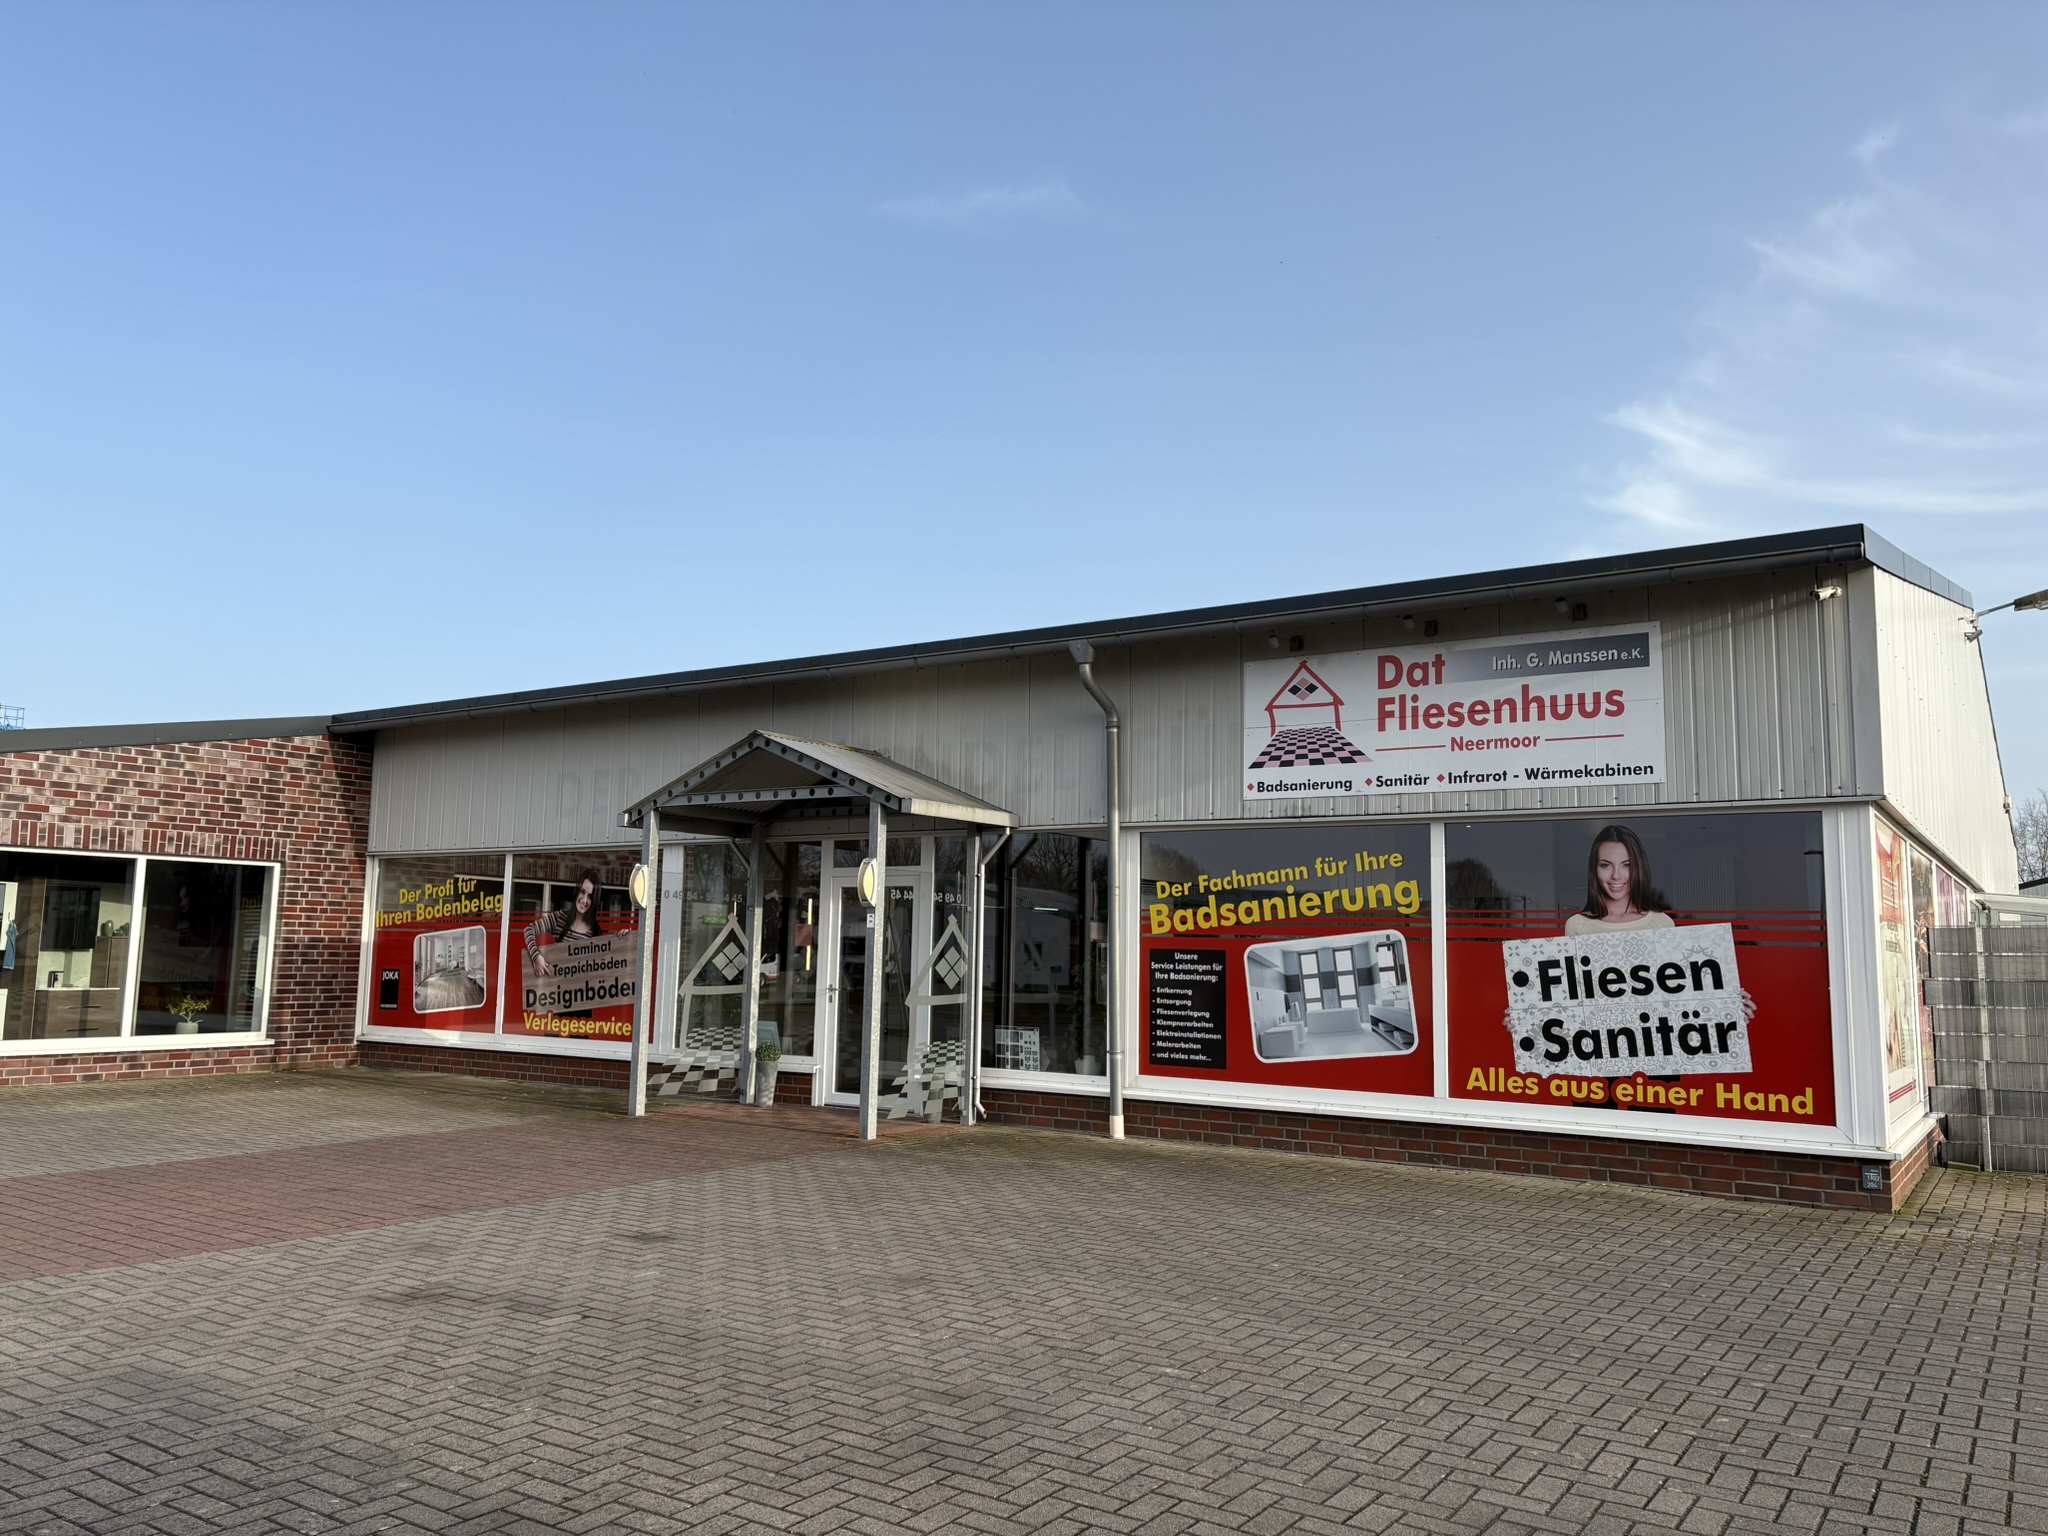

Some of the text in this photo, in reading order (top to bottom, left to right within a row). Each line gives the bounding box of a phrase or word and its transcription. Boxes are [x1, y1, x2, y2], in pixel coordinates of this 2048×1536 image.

[1492, 648, 1644, 671] Inh. G. Manssen e.K.
[1377, 653, 1446, 689] Dat
[1377, 684, 1625, 732] Fliesenhuus
[1450, 735, 1540, 751] Neermoor
[1257, 779, 1353, 793] Badsanierung
[1375, 773, 1430, 787] Sanitär
[1448, 770, 1508, 784] Infrarot
[1524, 763, 1654, 780] Wärmekabinen
[1156, 851, 1404, 899] Der Fachmann für Ihre
[400, 877, 477, 904] Der Profi für
[375, 891, 504, 928] Ihren Bodenbelag
[1149, 879, 1422, 934] Badsanierung
[568, 940, 611, 957] Laminat
[1174, 952, 1198, 960] Unsere
[382, 970, 399, 980] JOKA
[552, 957, 628, 978] Teppichböden
[1151, 962, 1222, 972] Service Leistungen für
[1170, 972, 1218, 983] Badsanierung:
[1537, 955, 1724, 1002] Fliesen
[1156, 987, 1192, 996] Entkernung
[1156, 998, 1192, 1006] Entsorgung
[1156, 1008, 1210, 1018] Fliesenverlegung
[523, 1012, 631, 1036] Verlegeservice
[1156, 1019, 1213, 1028] Klempnerarbeiten
[1156, 1030, 1222, 1039] Elektroinstallationen
[1541, 1010, 1738, 1062] Sanitär
[1156, 1040, 1201, 1049] Malerarbeiten
[1170, 1052, 1188, 1060] vieles
[1466, 1067, 1814, 1115] Alles aus einer Hand
